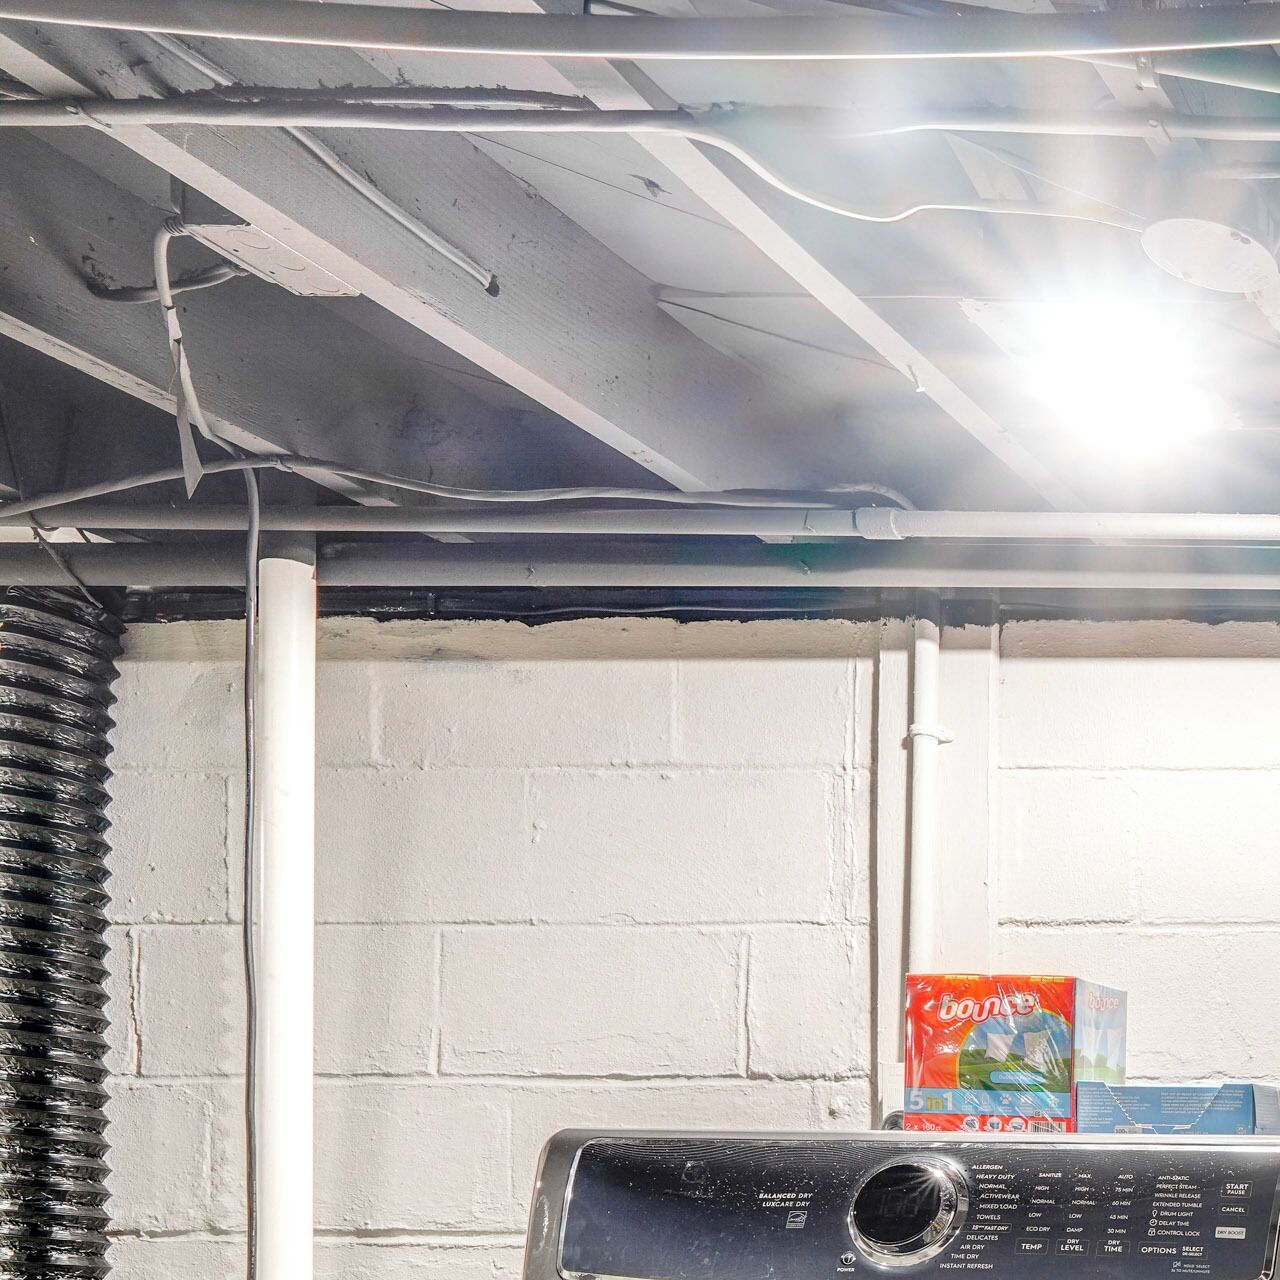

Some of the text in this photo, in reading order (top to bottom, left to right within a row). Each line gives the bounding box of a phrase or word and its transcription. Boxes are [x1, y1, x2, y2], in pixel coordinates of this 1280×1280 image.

[937, 993, 1036, 1024] bounce
[1088, 992, 1120, 1011] bounce
[909, 1091, 953, 1111] 5 in 1
[1141, 1247, 1177, 1255] OPTIONS
